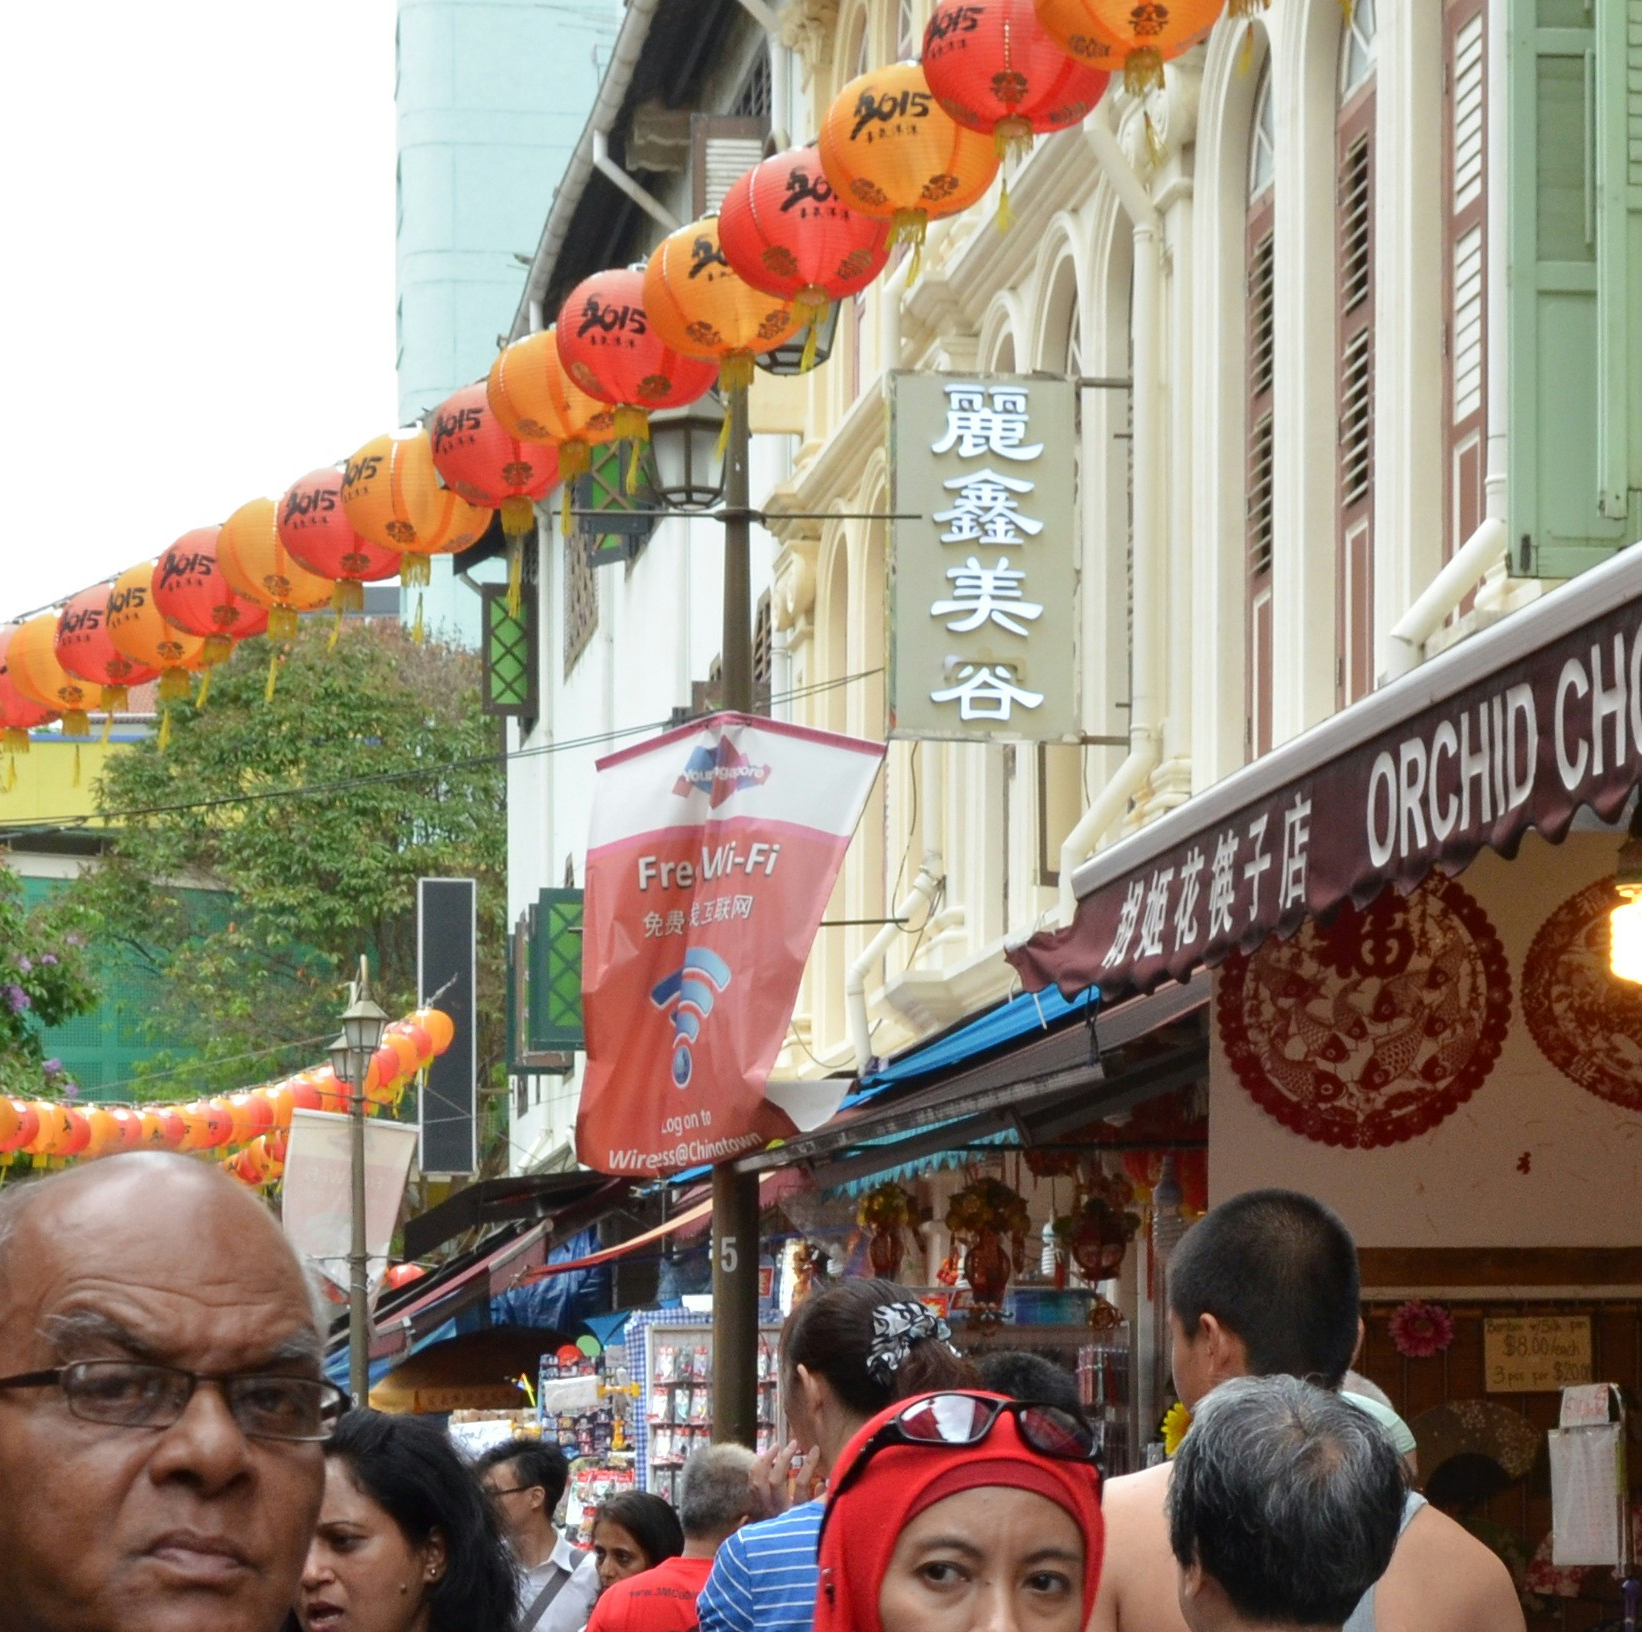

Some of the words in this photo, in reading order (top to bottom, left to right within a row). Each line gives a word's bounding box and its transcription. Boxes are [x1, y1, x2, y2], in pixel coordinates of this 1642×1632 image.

[850, 87, 933, 140] 2015
[577, 293, 647, 338] 2015
[435, 408, 484, 453] 2015
[1368, 680, 1539, 869] ORCHID
[637, 855, 699, 891] Fre
[702, 840, 781, 881] Wi-Fi
[1101, 799, 1314, 970] 胡姬花筷子店
[684, 1113, 699, 1131] on
[700, 1109, 712, 1126] to
[720, 1236, 738, 1273] 5
[1492, 1365, 1505, 1385] 3
